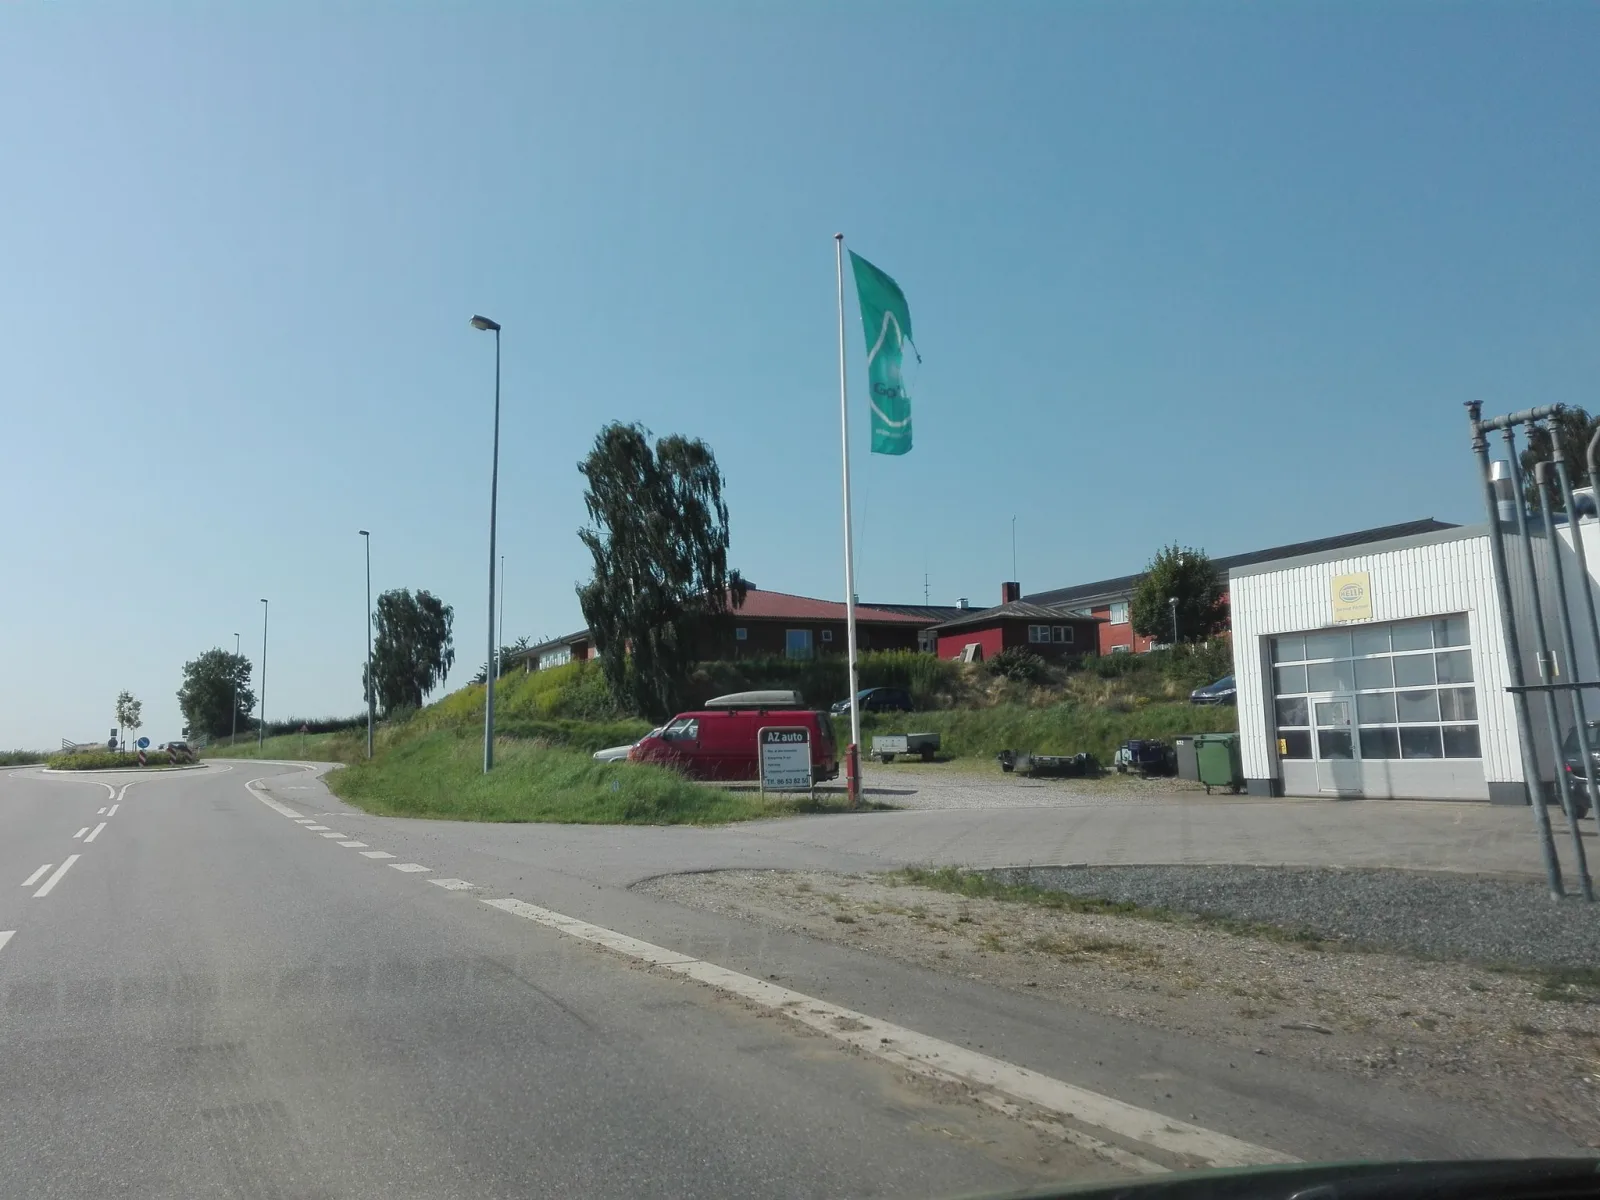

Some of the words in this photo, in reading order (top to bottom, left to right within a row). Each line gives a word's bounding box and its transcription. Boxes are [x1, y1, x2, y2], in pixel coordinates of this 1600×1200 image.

[1340, 588, 1364, 597] HELLA
[767, 732, 780, 742] AZ
[781, 732, 803, 742] auto
